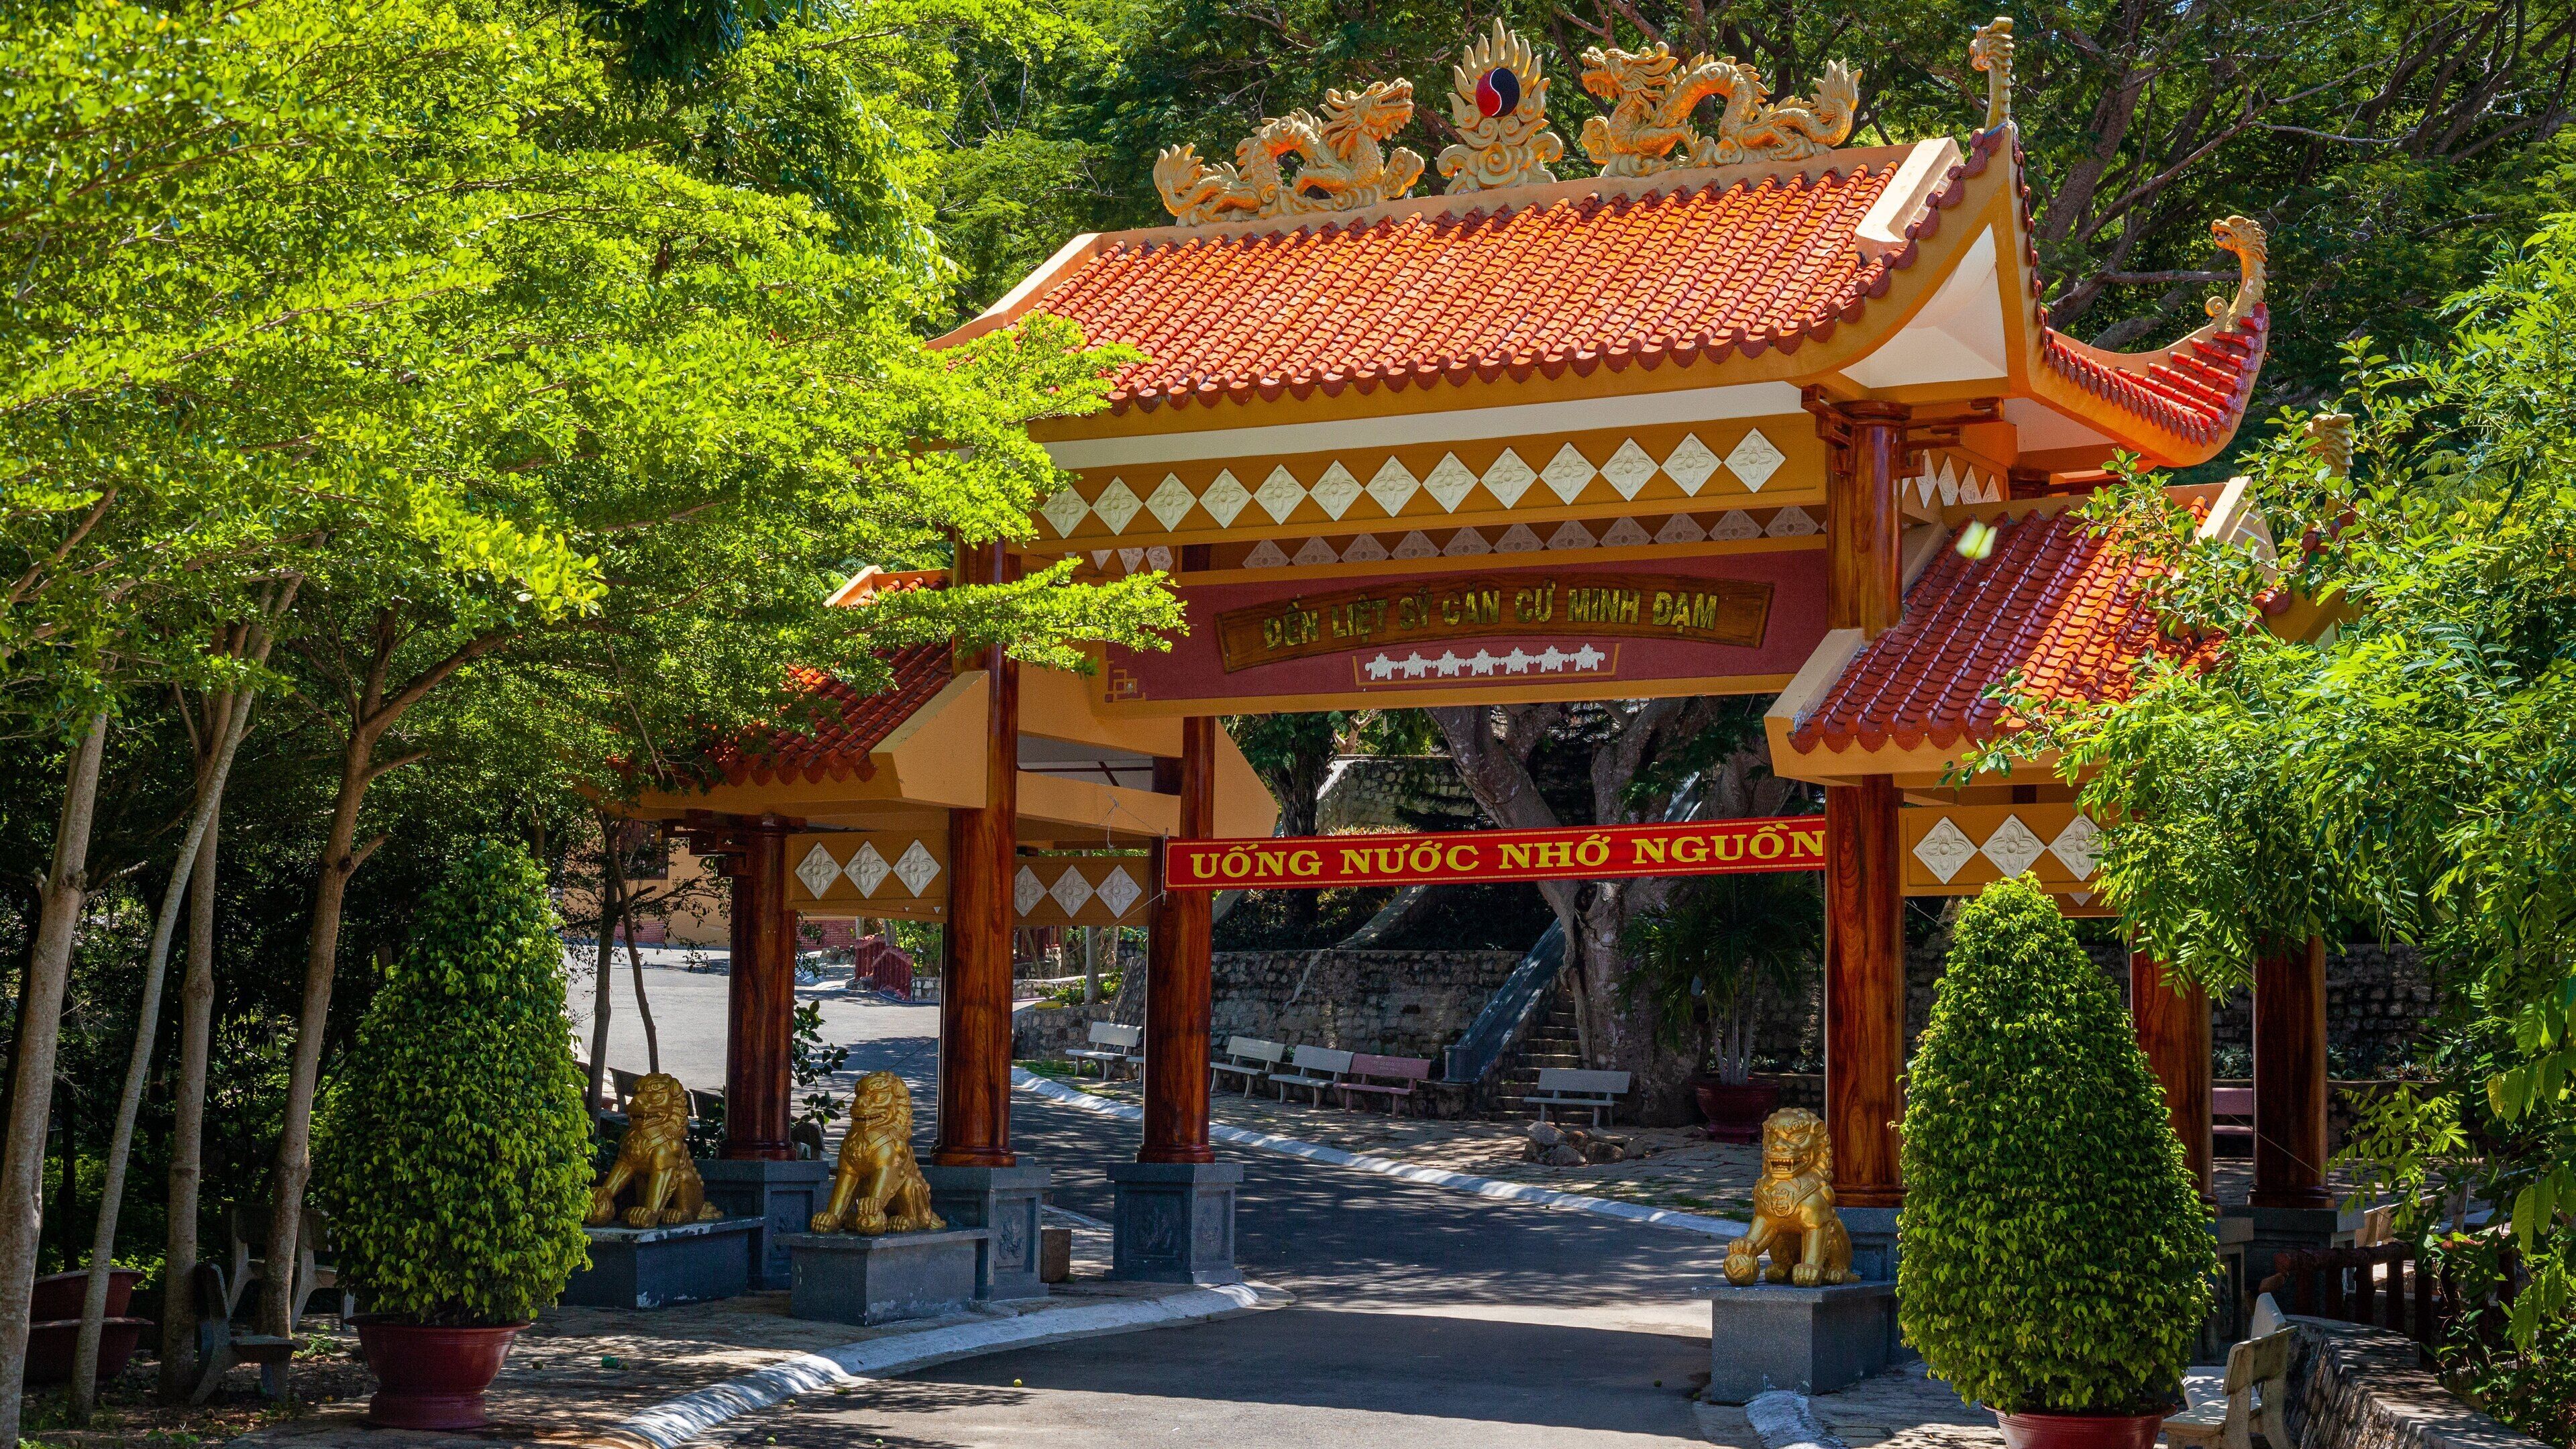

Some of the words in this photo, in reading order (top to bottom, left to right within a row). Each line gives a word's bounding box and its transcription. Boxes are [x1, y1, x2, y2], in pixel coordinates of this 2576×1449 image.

[1332, 594, 1388, 643] LIỆT
[1399, 587, 1433, 631] SỸ
[1442, 583, 1500, 626] CĂN
[1515, 580, 1556, 623] CỨ
[1567, 588, 1641, 625] MINH
[1652, 591, 1717, 633] ĐẠM
[1190, 843, 1323, 879] UỐNG
[1340, 840, 1479, 874] NƯỚC
[1498, 834, 1611, 869] NHỚ
[1631, 823, 1825, 864] NGUỒN
